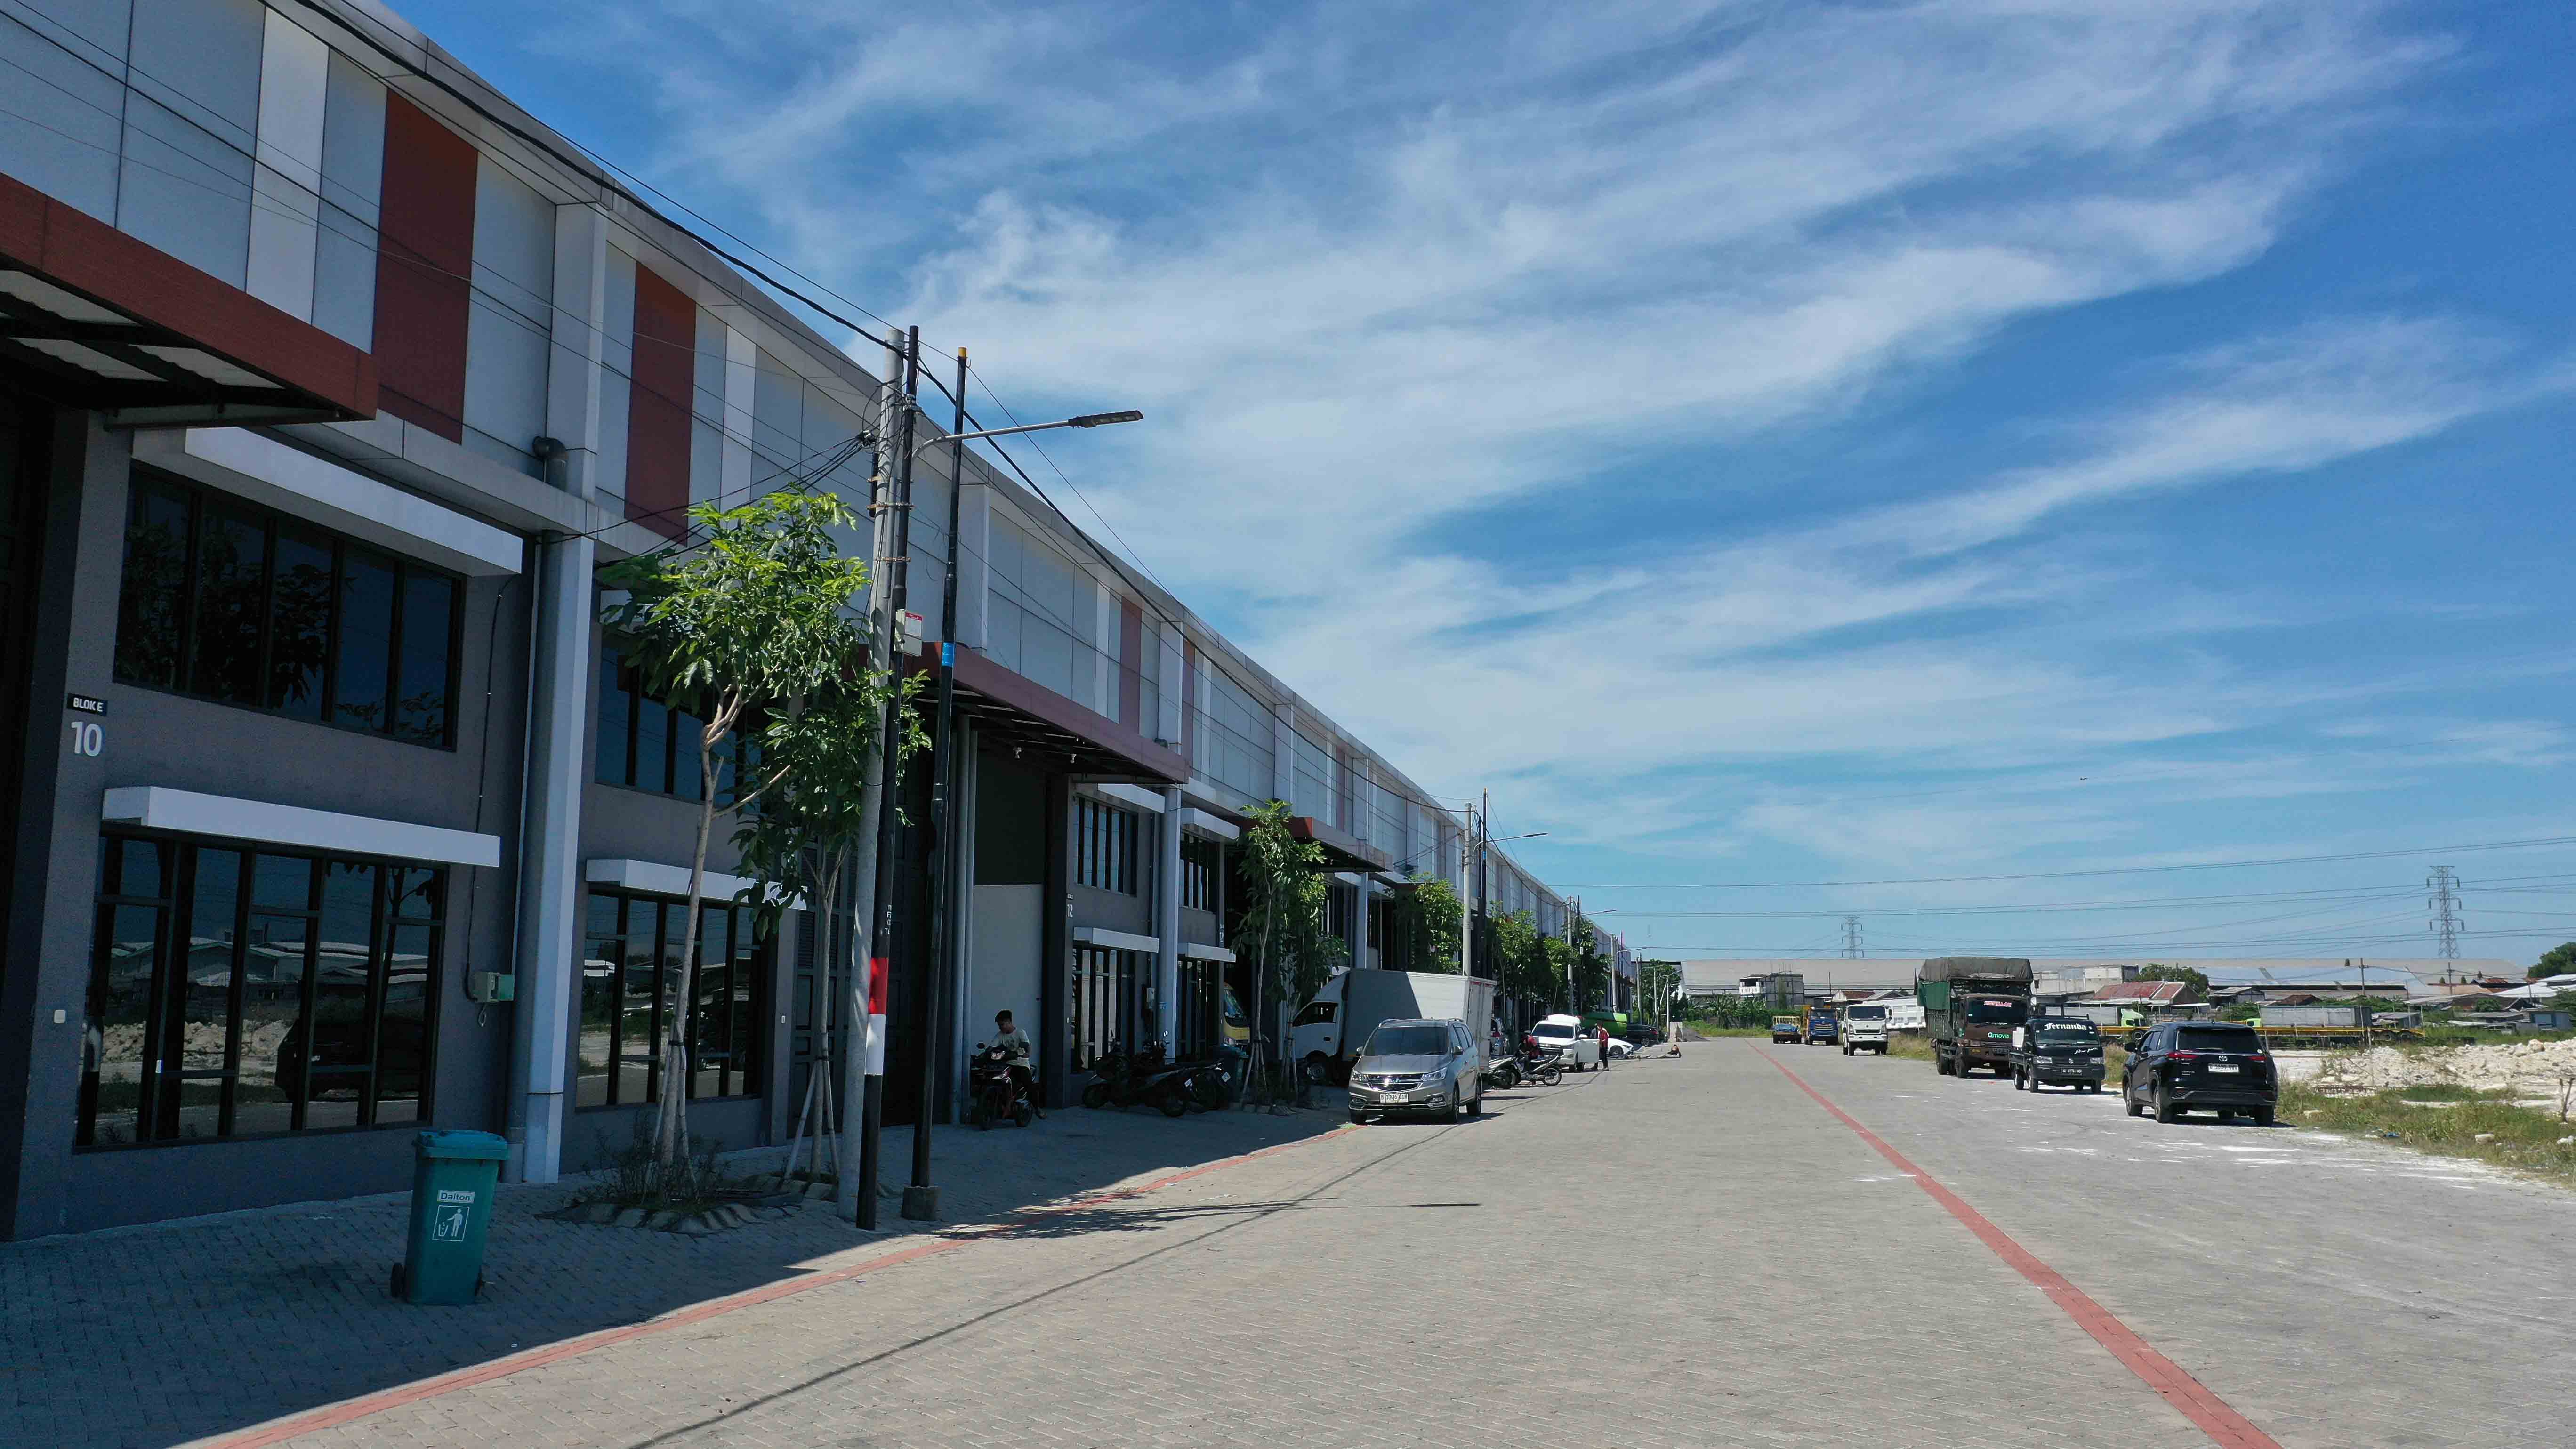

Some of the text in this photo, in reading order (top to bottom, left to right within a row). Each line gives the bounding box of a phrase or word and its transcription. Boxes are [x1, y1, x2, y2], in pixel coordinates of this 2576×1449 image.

[73, 697, 104, 712] BLOK E
[71, 721, 102, 757] 10
[1067, 903, 1073, 918] 12
[440, 1192, 470, 1201] Dalton
